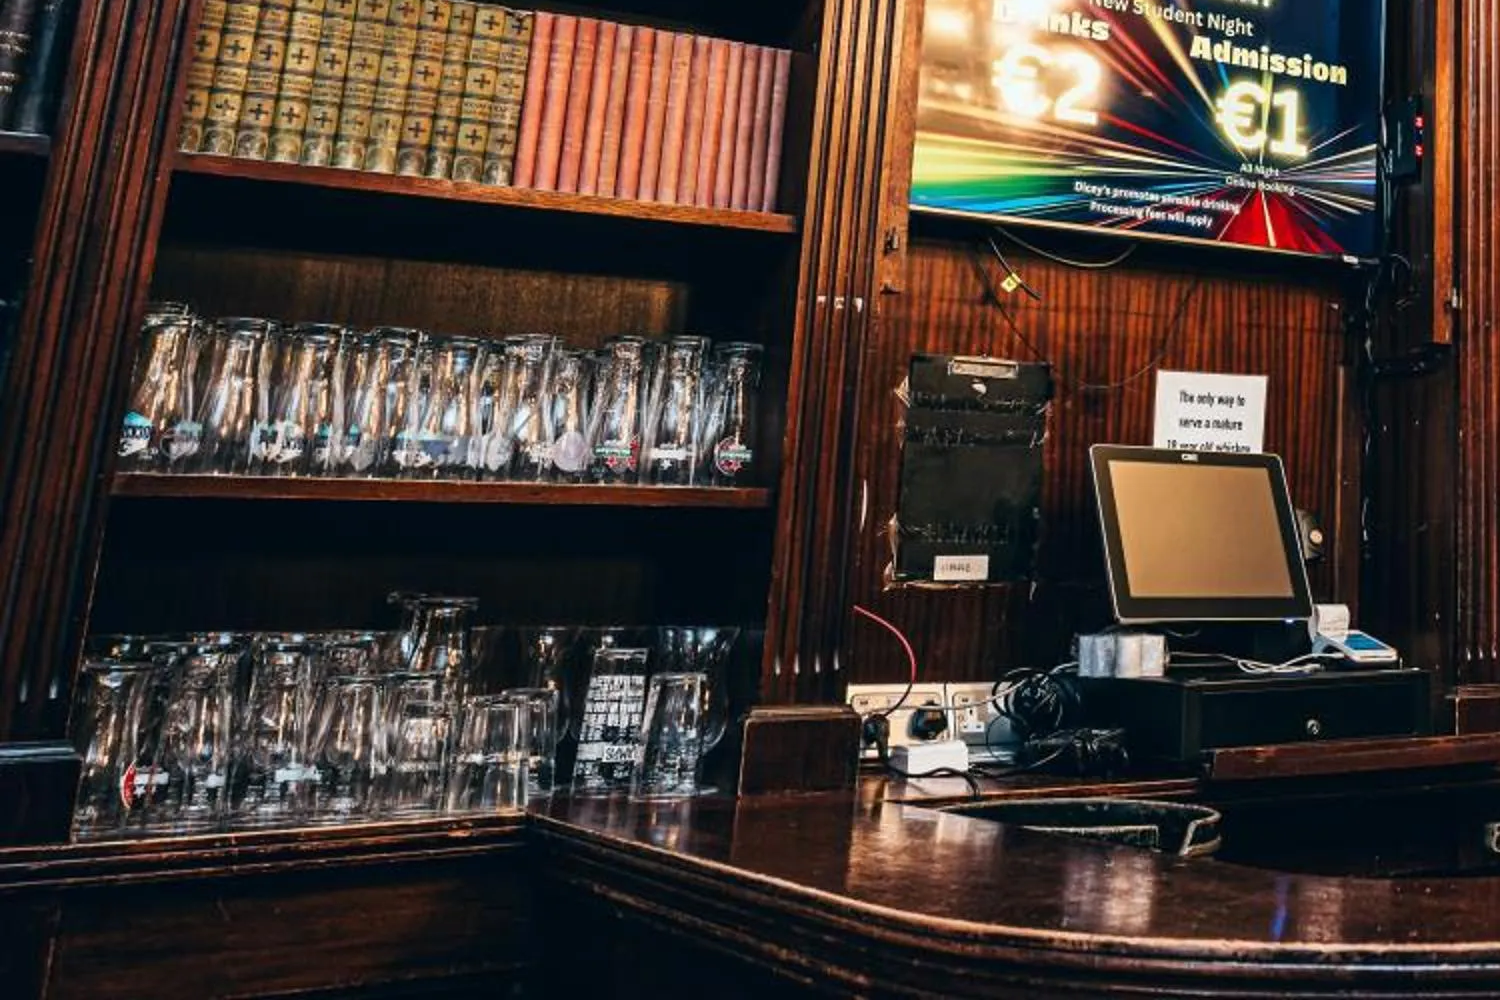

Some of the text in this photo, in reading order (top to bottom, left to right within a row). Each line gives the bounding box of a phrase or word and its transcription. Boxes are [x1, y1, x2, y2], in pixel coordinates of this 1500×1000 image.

[1132, 0, 1204, 28] Student
[1207, 10, 1254, 38] Night
[1190, 34, 1347, 86] Admission
[1215, 80, 1309, 159] €1
[1180, 390, 1246, 409] The only way to
[1179, 418, 1243, 431] serve a mature
